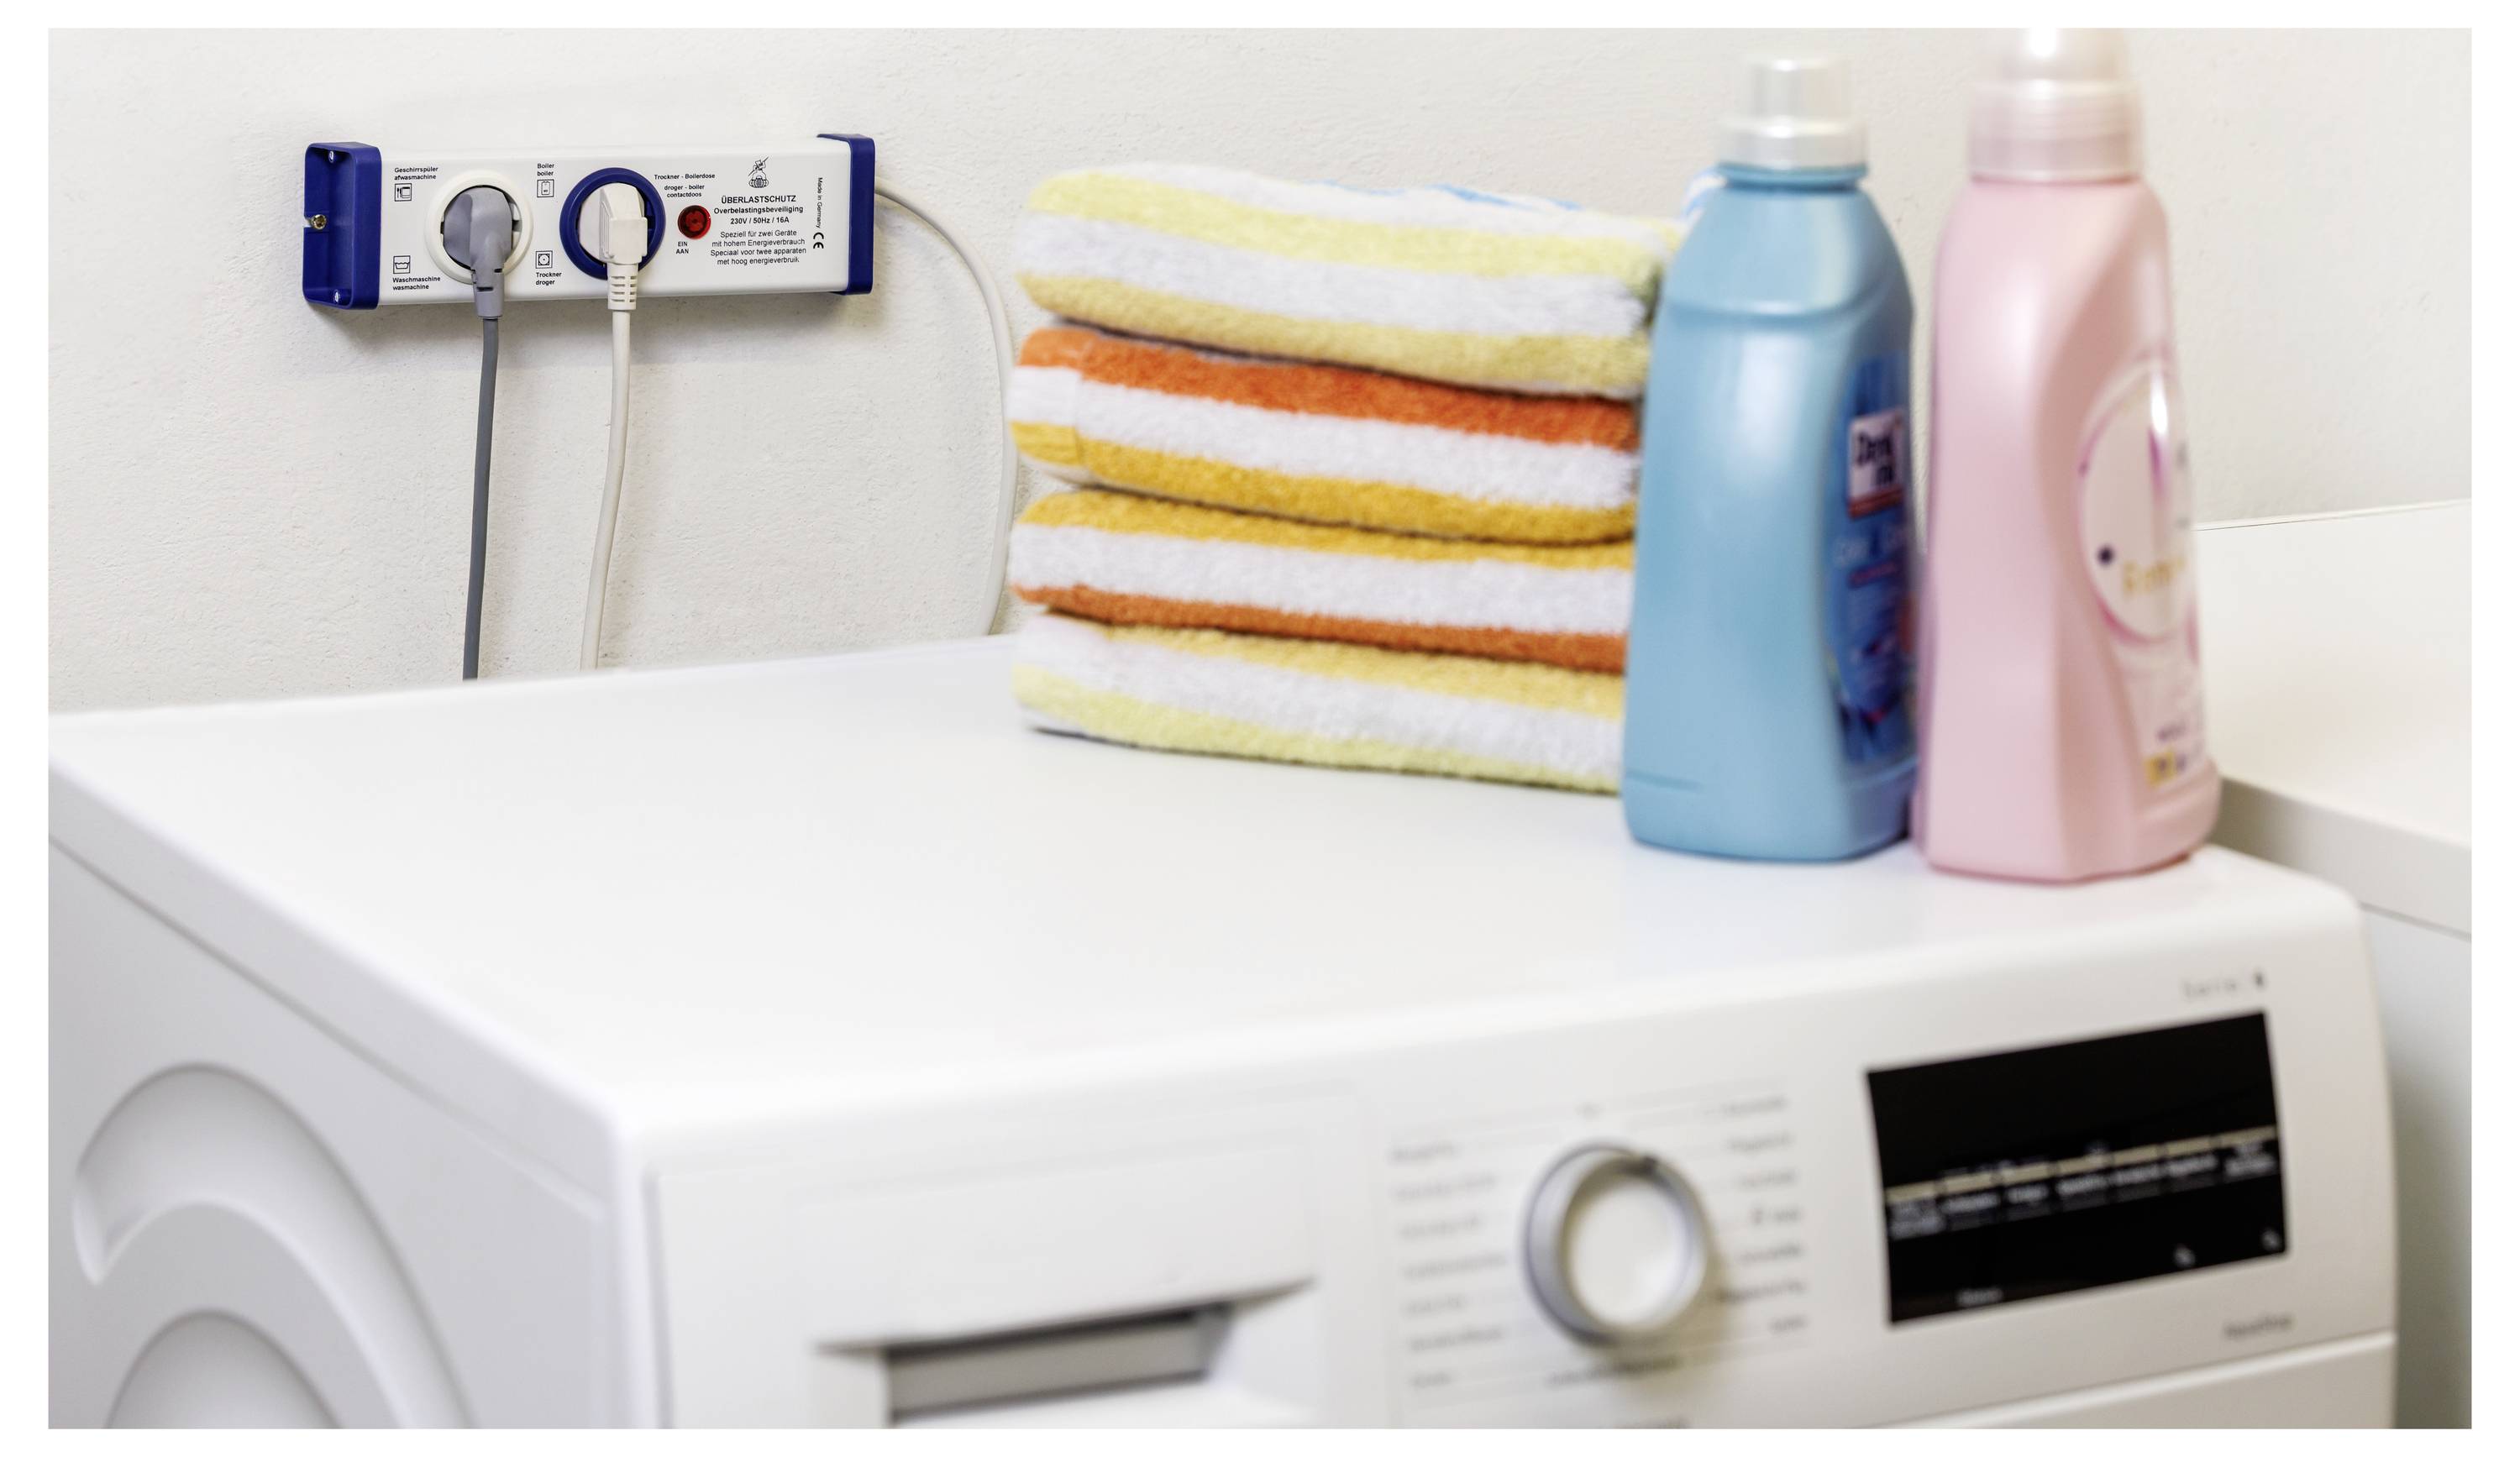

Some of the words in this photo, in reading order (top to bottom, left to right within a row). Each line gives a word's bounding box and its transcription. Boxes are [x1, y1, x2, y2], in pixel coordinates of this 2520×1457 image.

[721, 195, 796, 204] ÜBERLASTSCHUTZ
[714, 206, 804, 214] Overbelastingsbeveiliging
[720, 231, 747, 239] Speziell
[748, 238, 806, 247] Energieverbrauch
[710, 249, 739, 257] Speciaal
[774, 247, 806, 255] apparaten
